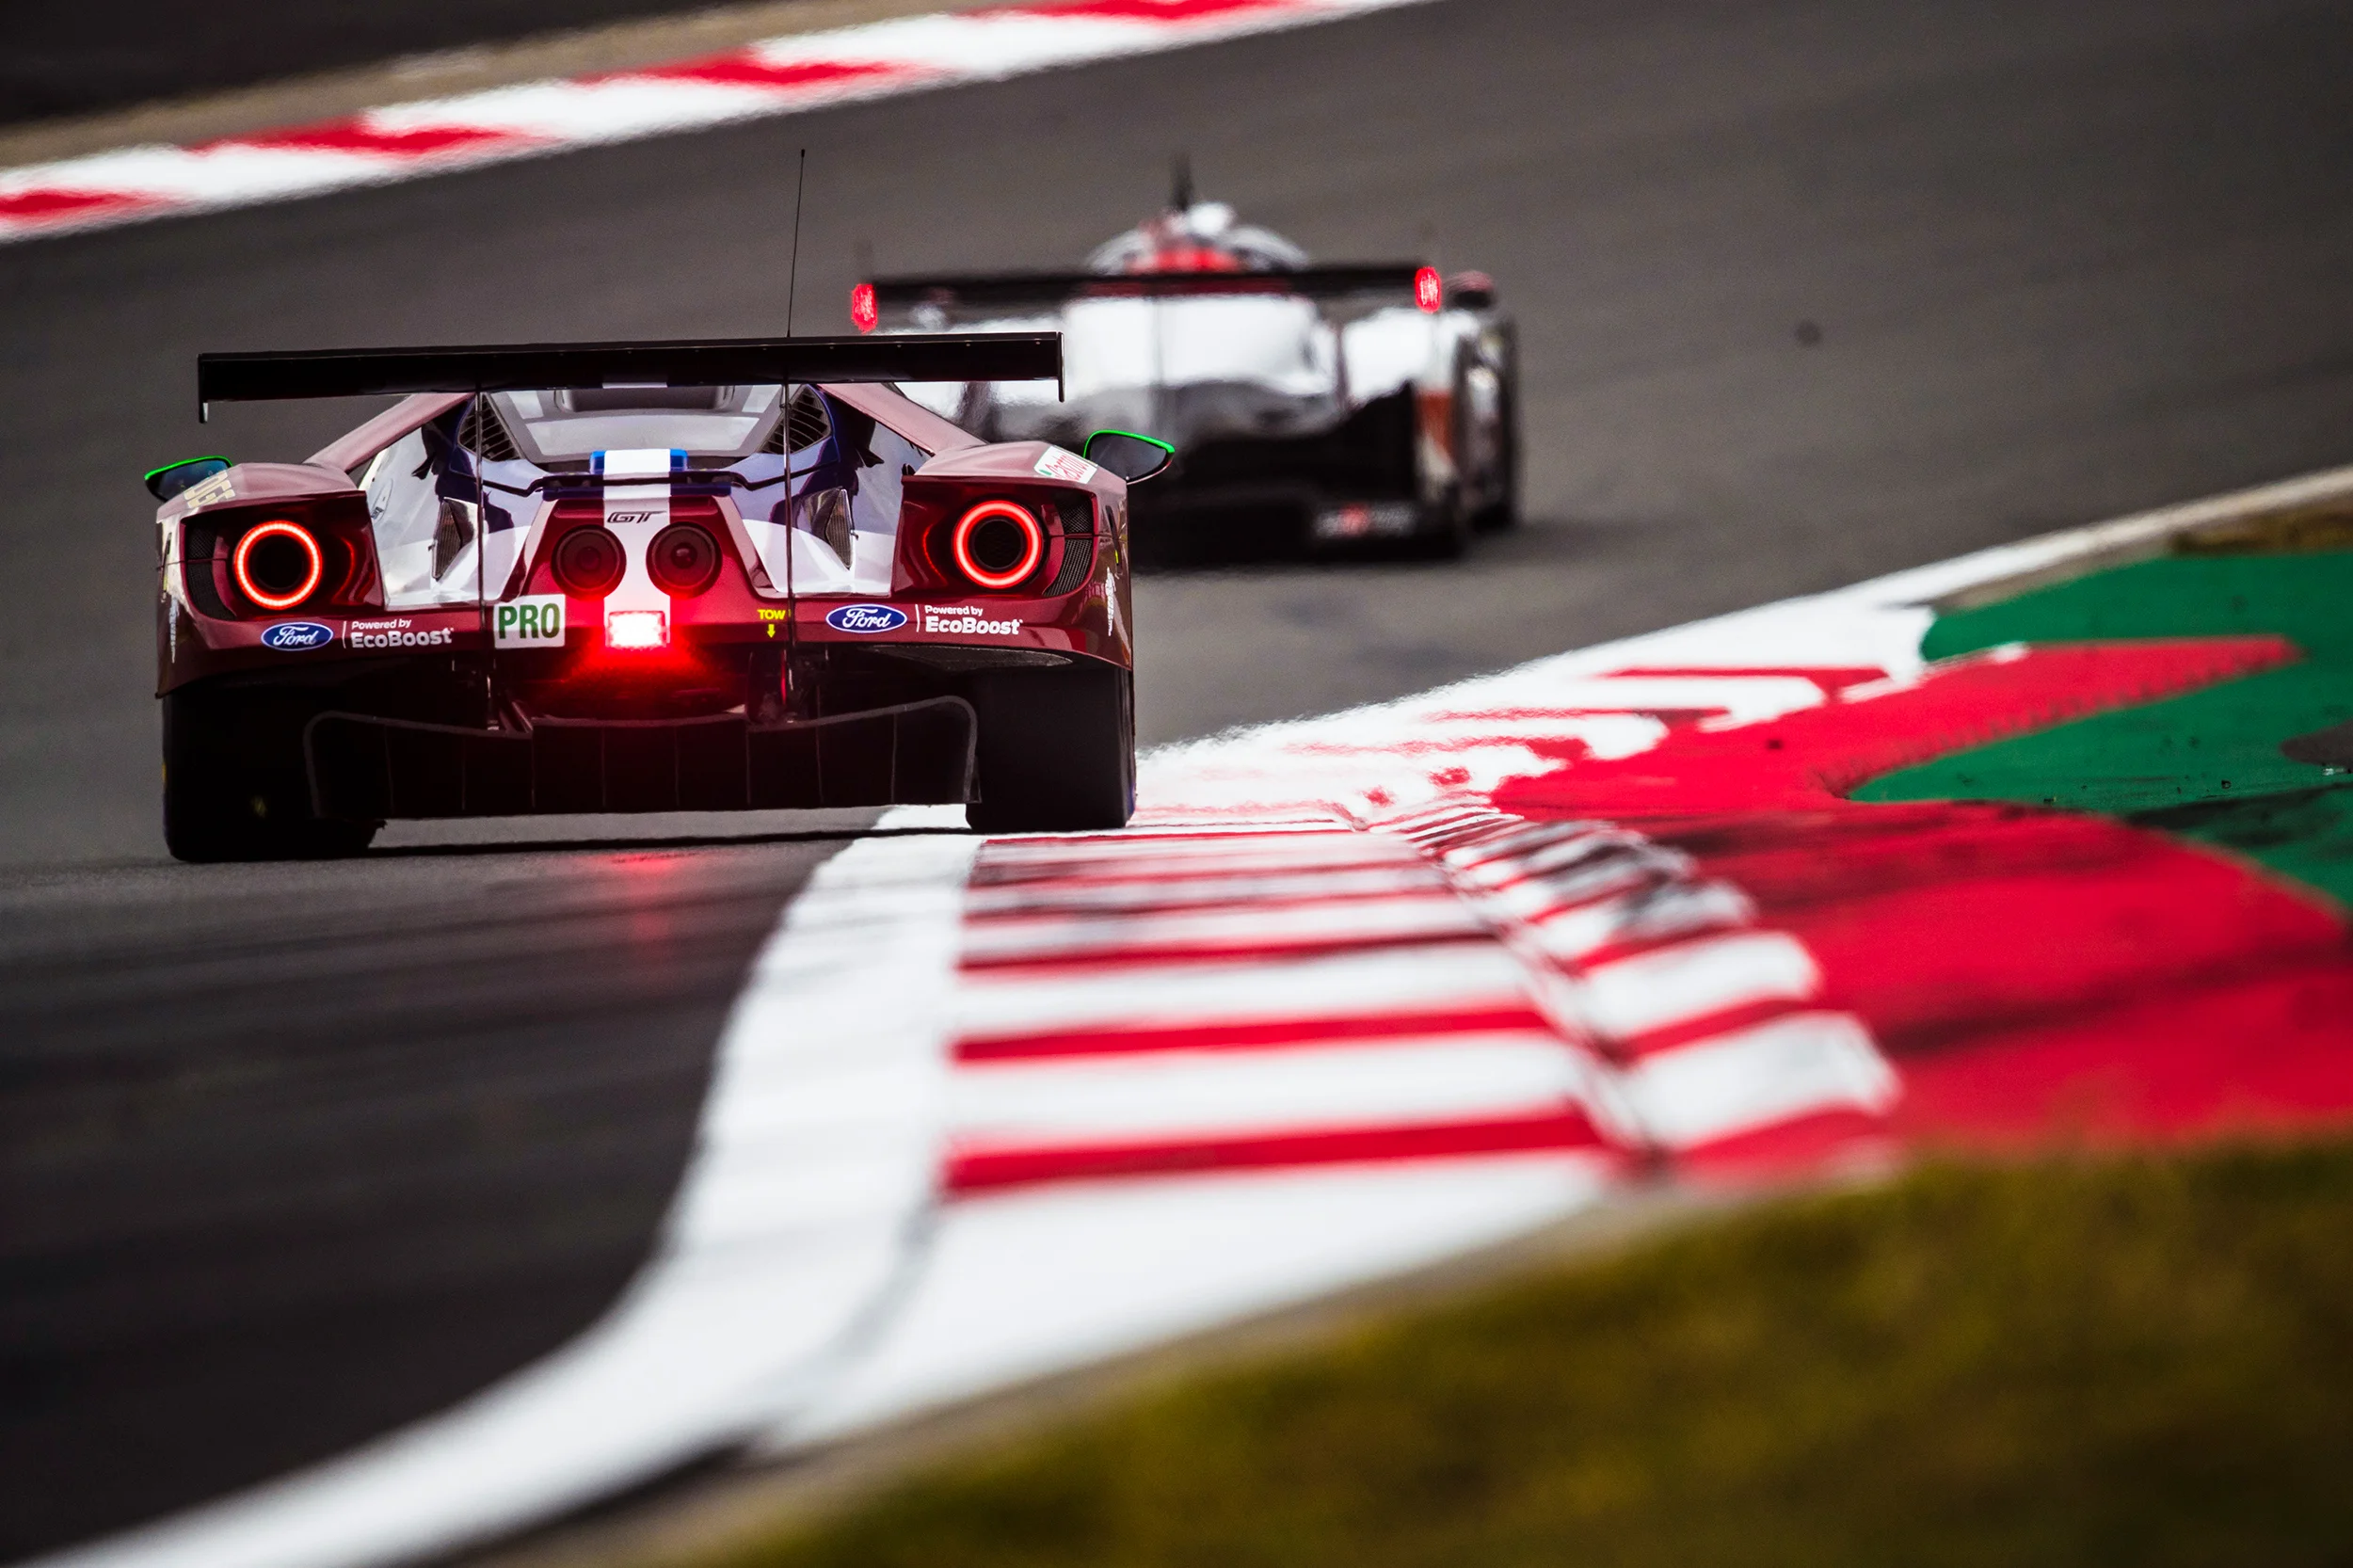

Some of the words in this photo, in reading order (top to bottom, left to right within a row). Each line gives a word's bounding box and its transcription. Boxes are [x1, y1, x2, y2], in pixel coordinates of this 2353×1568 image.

[607, 510, 667, 523] GT
[758, 609, 786, 619] TOW
[924, 605, 969, 616] Powered
[969, 606, 984, 617] by
[351, 619, 397, 630] Powered
[398, 618, 412, 629] by
[498, 602, 561, 640] PRO
[925, 616, 1021, 635] EcoBoost
[350, 628, 454, 648] EcoBoost
